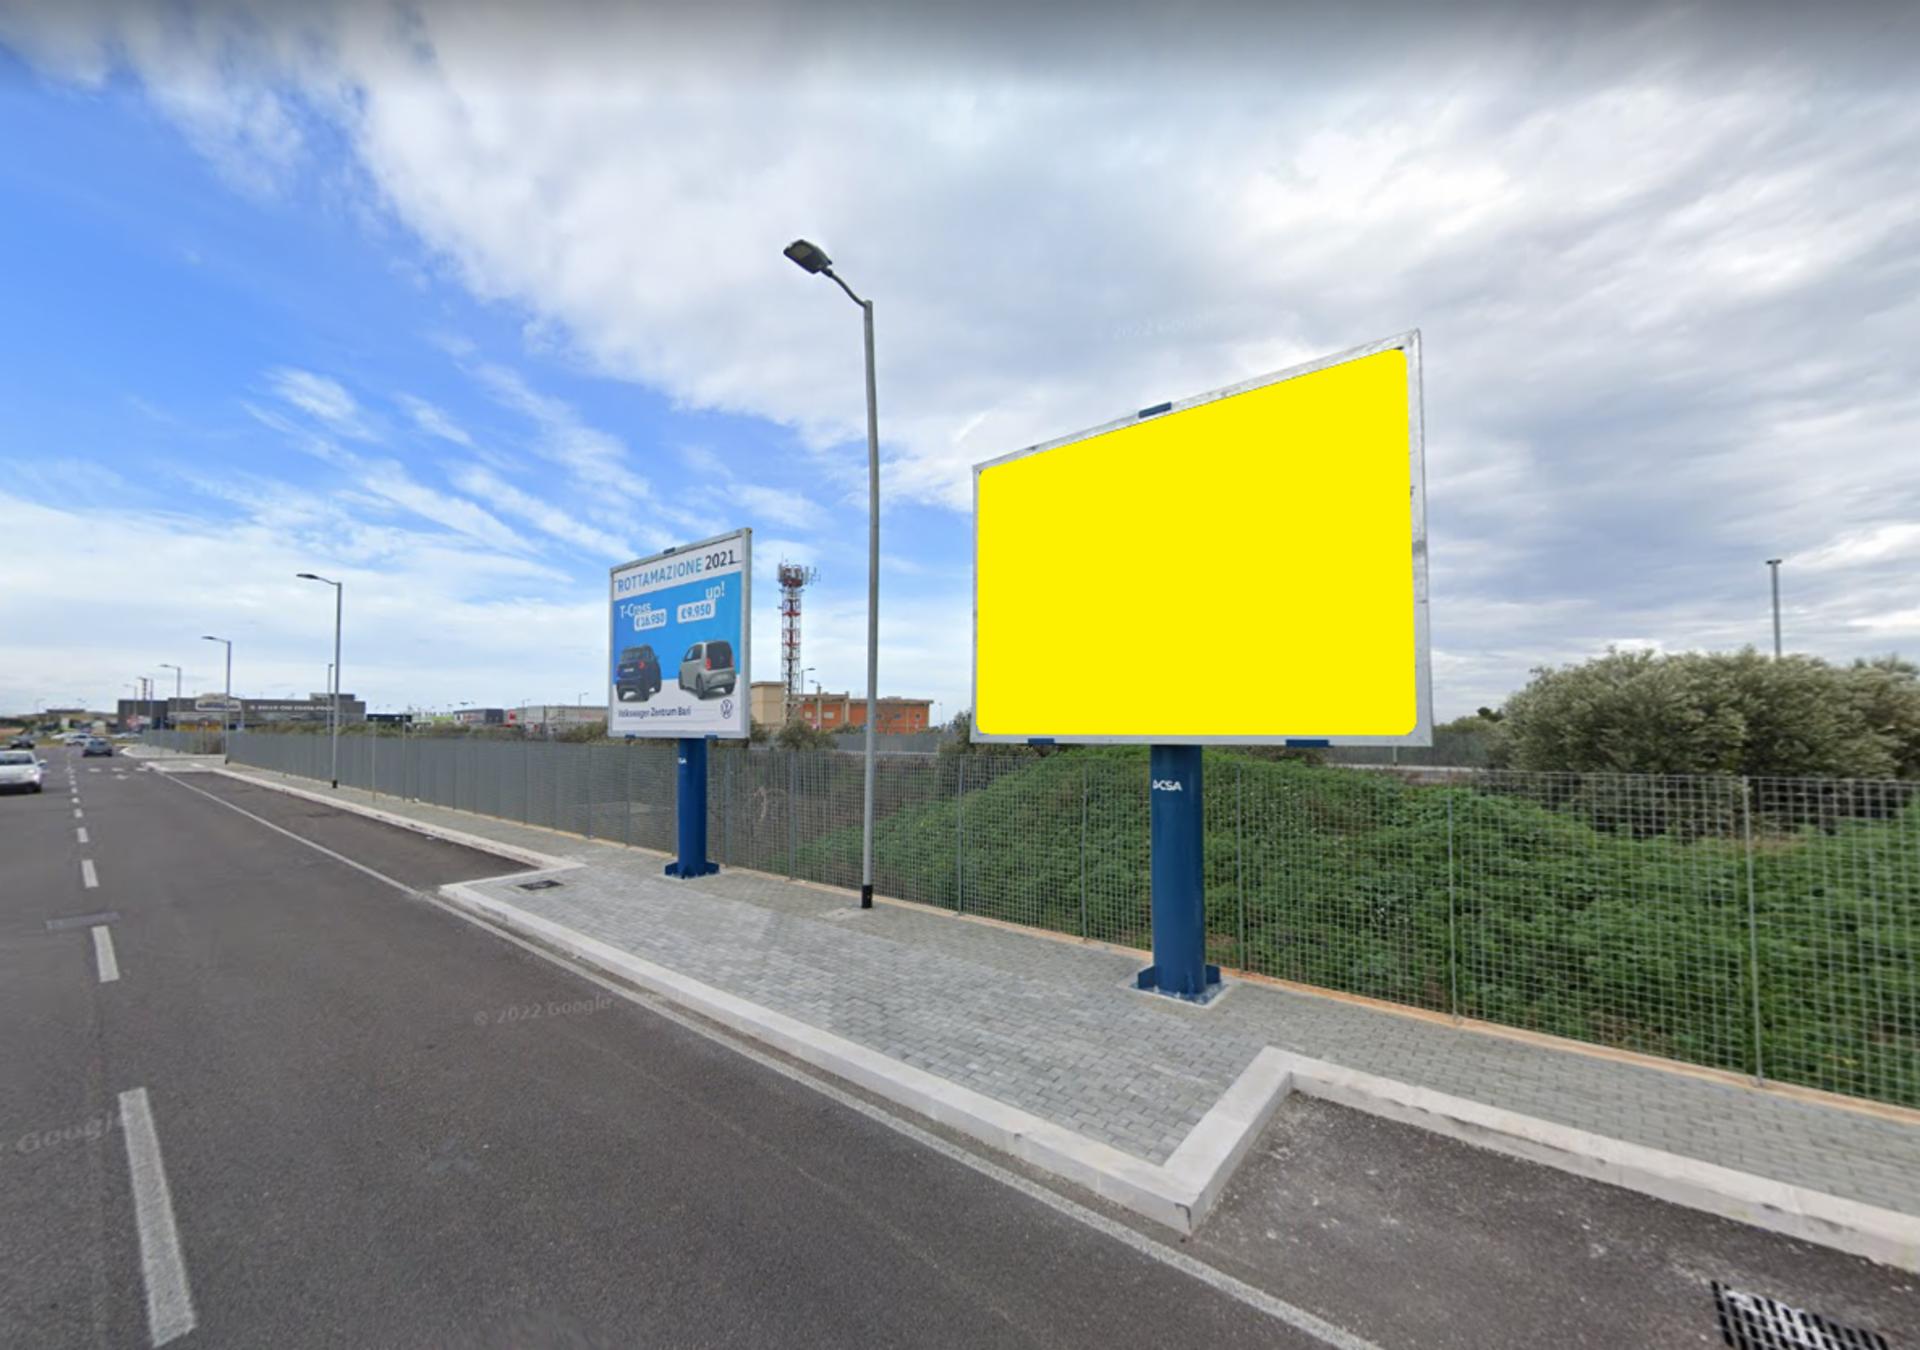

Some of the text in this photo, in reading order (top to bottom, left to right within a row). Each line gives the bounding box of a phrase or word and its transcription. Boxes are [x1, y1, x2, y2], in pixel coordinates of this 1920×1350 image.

[617, 549, 736, 592] ROTTAMAZIONE 2021
[705, 581, 725, 601] up!
[681, 603, 711, 620] €9.950
